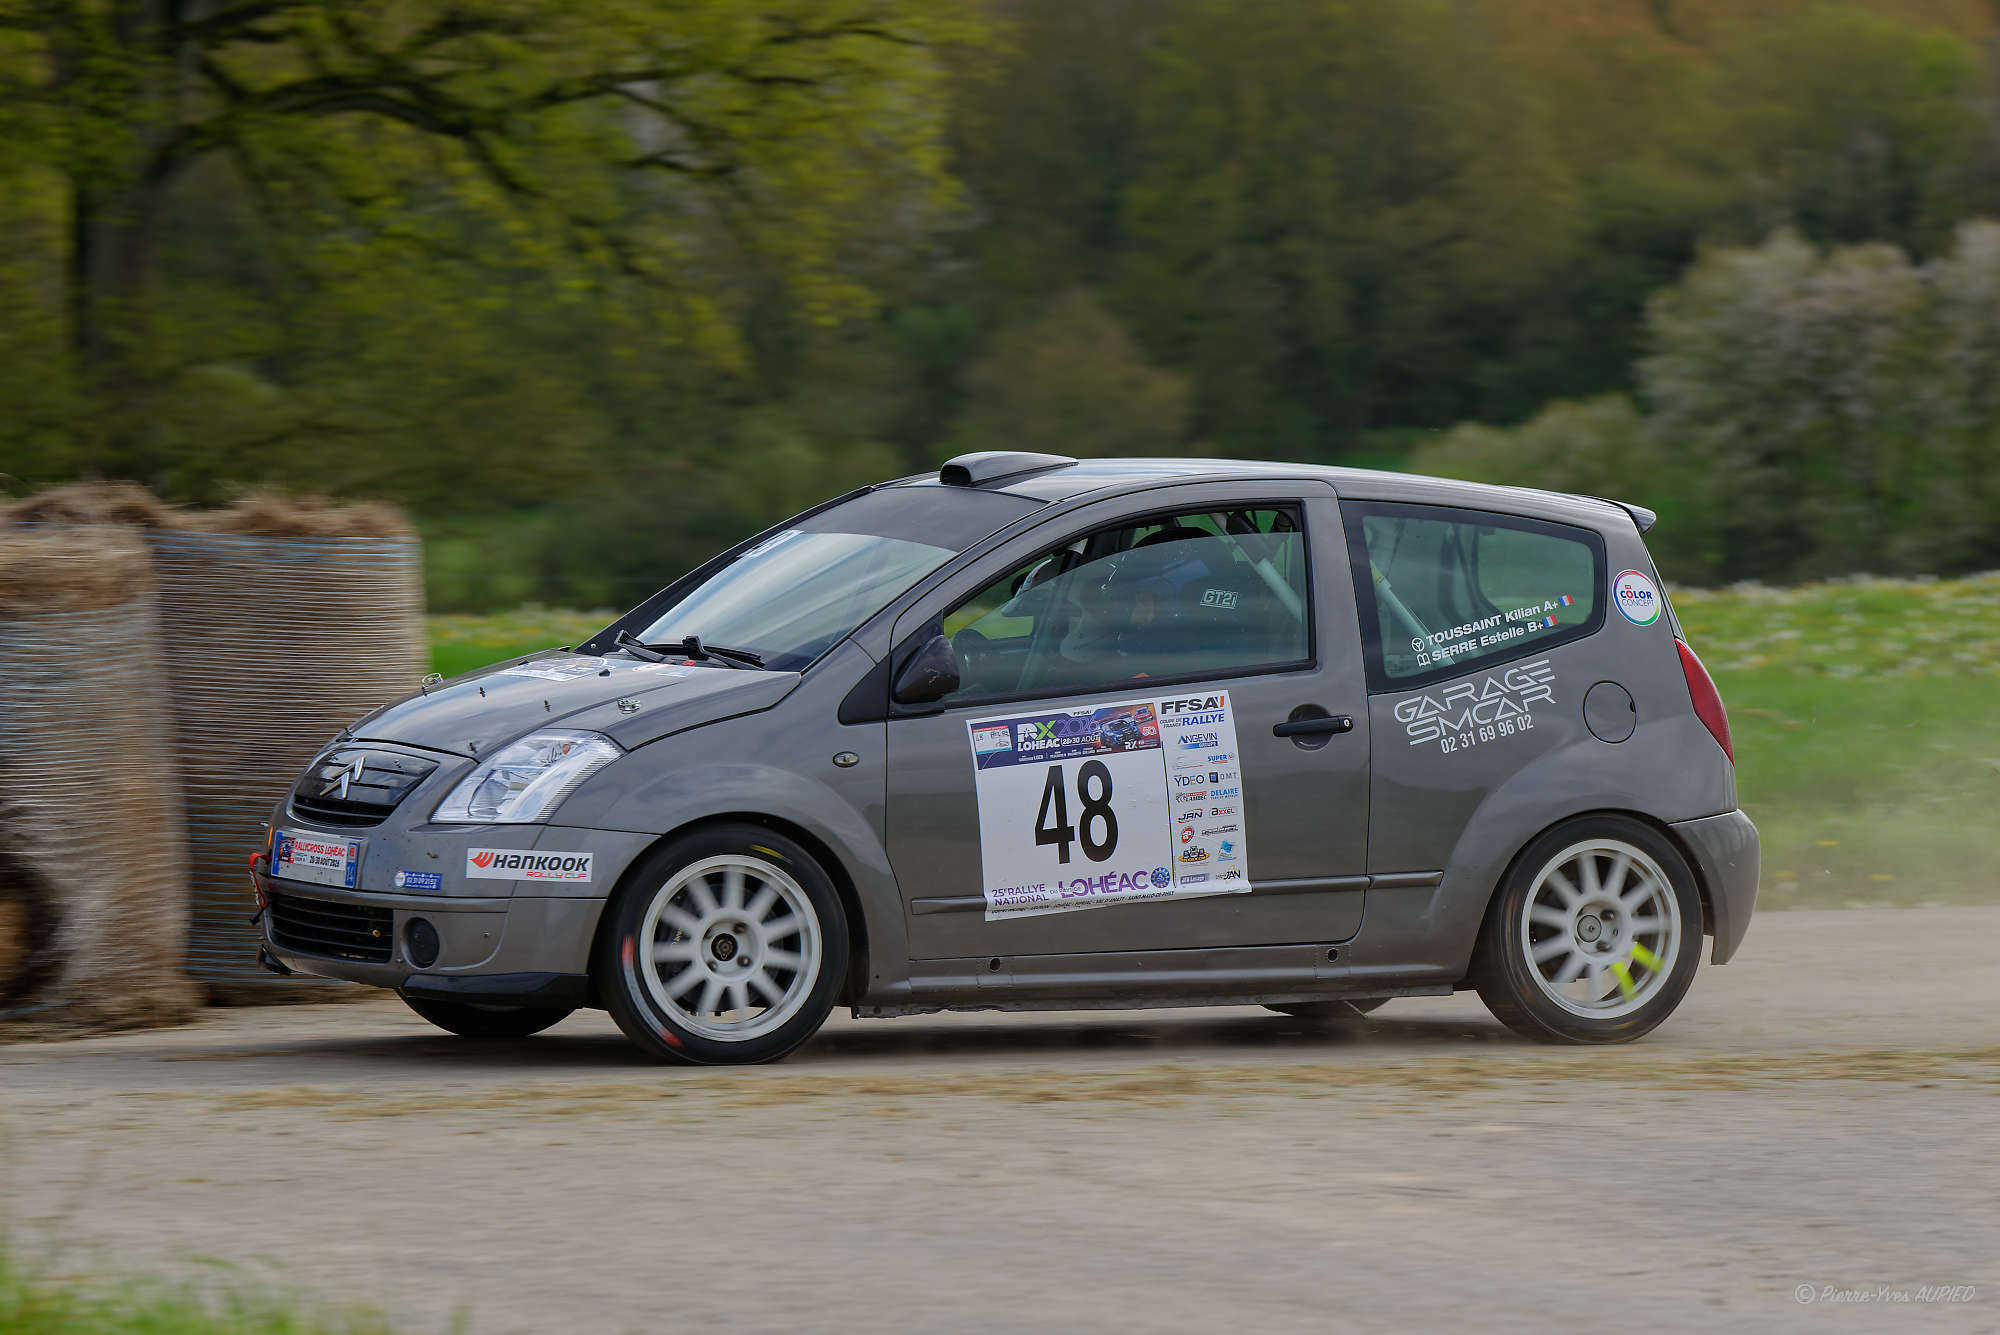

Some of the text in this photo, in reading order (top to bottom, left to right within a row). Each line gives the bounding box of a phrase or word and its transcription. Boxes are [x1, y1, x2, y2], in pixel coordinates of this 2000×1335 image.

[1620, 590, 1653, 600] COLOR
[1622, 599, 1654, 607] CONCEPT
[1426, 600, 1559, 647] TOUSSAINT Kilian A+
[1431, 620, 1544, 662] SERRE Estelle B+
[1394, 659, 1556, 723] GARAGE
[1161, 696, 1219, 714] FFSA
[1406, 684, 1556, 746] SMCAR
[1182, 713, 1225, 727] RALLYE
[1017, 719, 1057, 743] RX
[1177, 732, 1218, 744] ANGEVIN
[1440, 714, 1534, 754] 02 31 69 96 02
[1210, 788, 1239, 797] DELAIRE
[1034, 760, 1119, 865] 48
[1007, 883, 1046, 896] RALLYE
[1058, 870, 1149, 899] LOHÉAC
[995, 894, 1049, 906] NATIONAL
